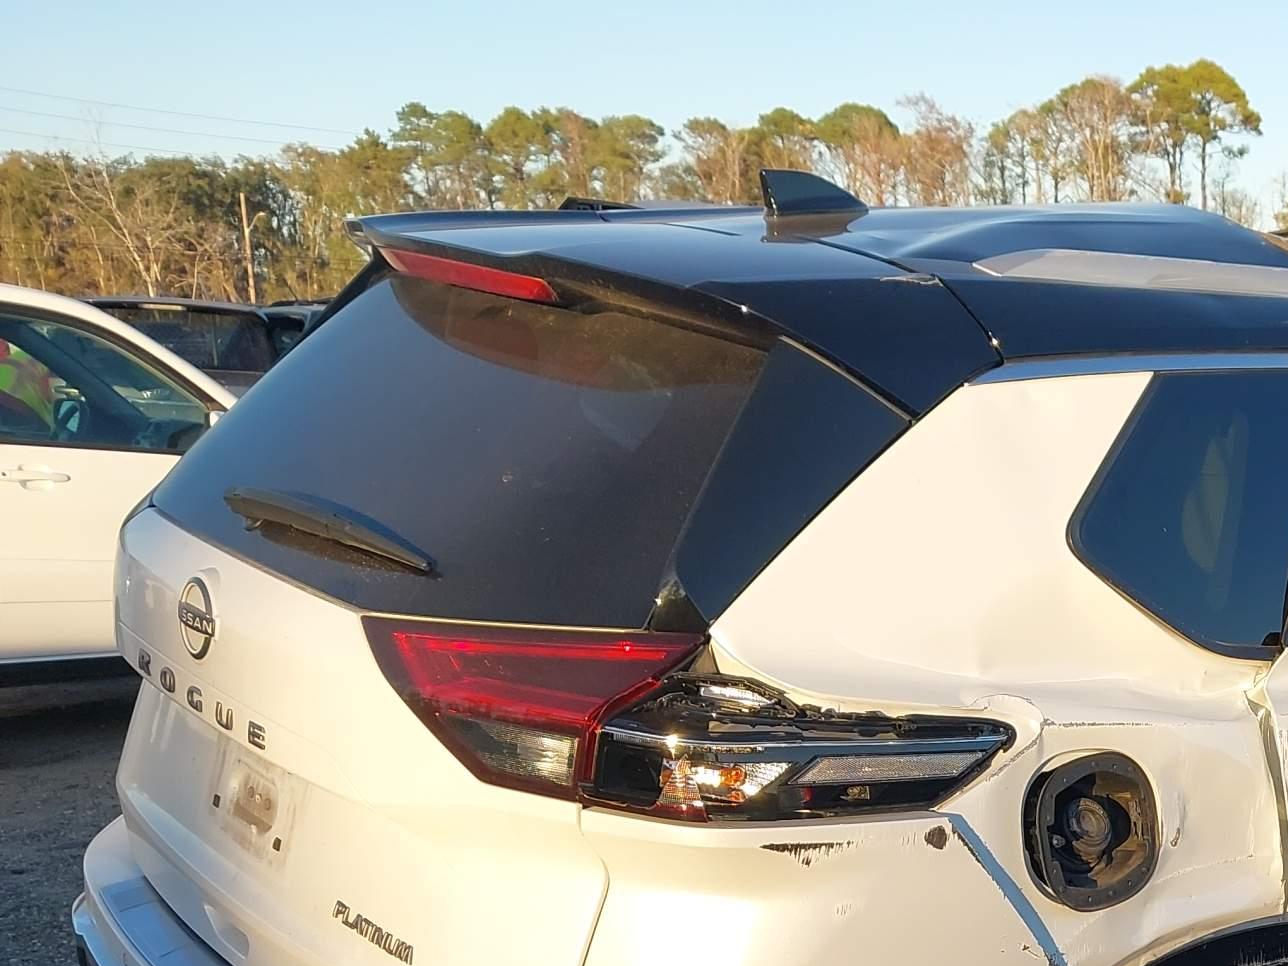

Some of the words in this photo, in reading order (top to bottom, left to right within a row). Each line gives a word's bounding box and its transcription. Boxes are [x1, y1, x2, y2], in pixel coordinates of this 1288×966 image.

[180, 606, 214, 635] SSAN
[138, 647, 266, 751] ROGUE
[332, 899, 414, 966] PLATINUM
